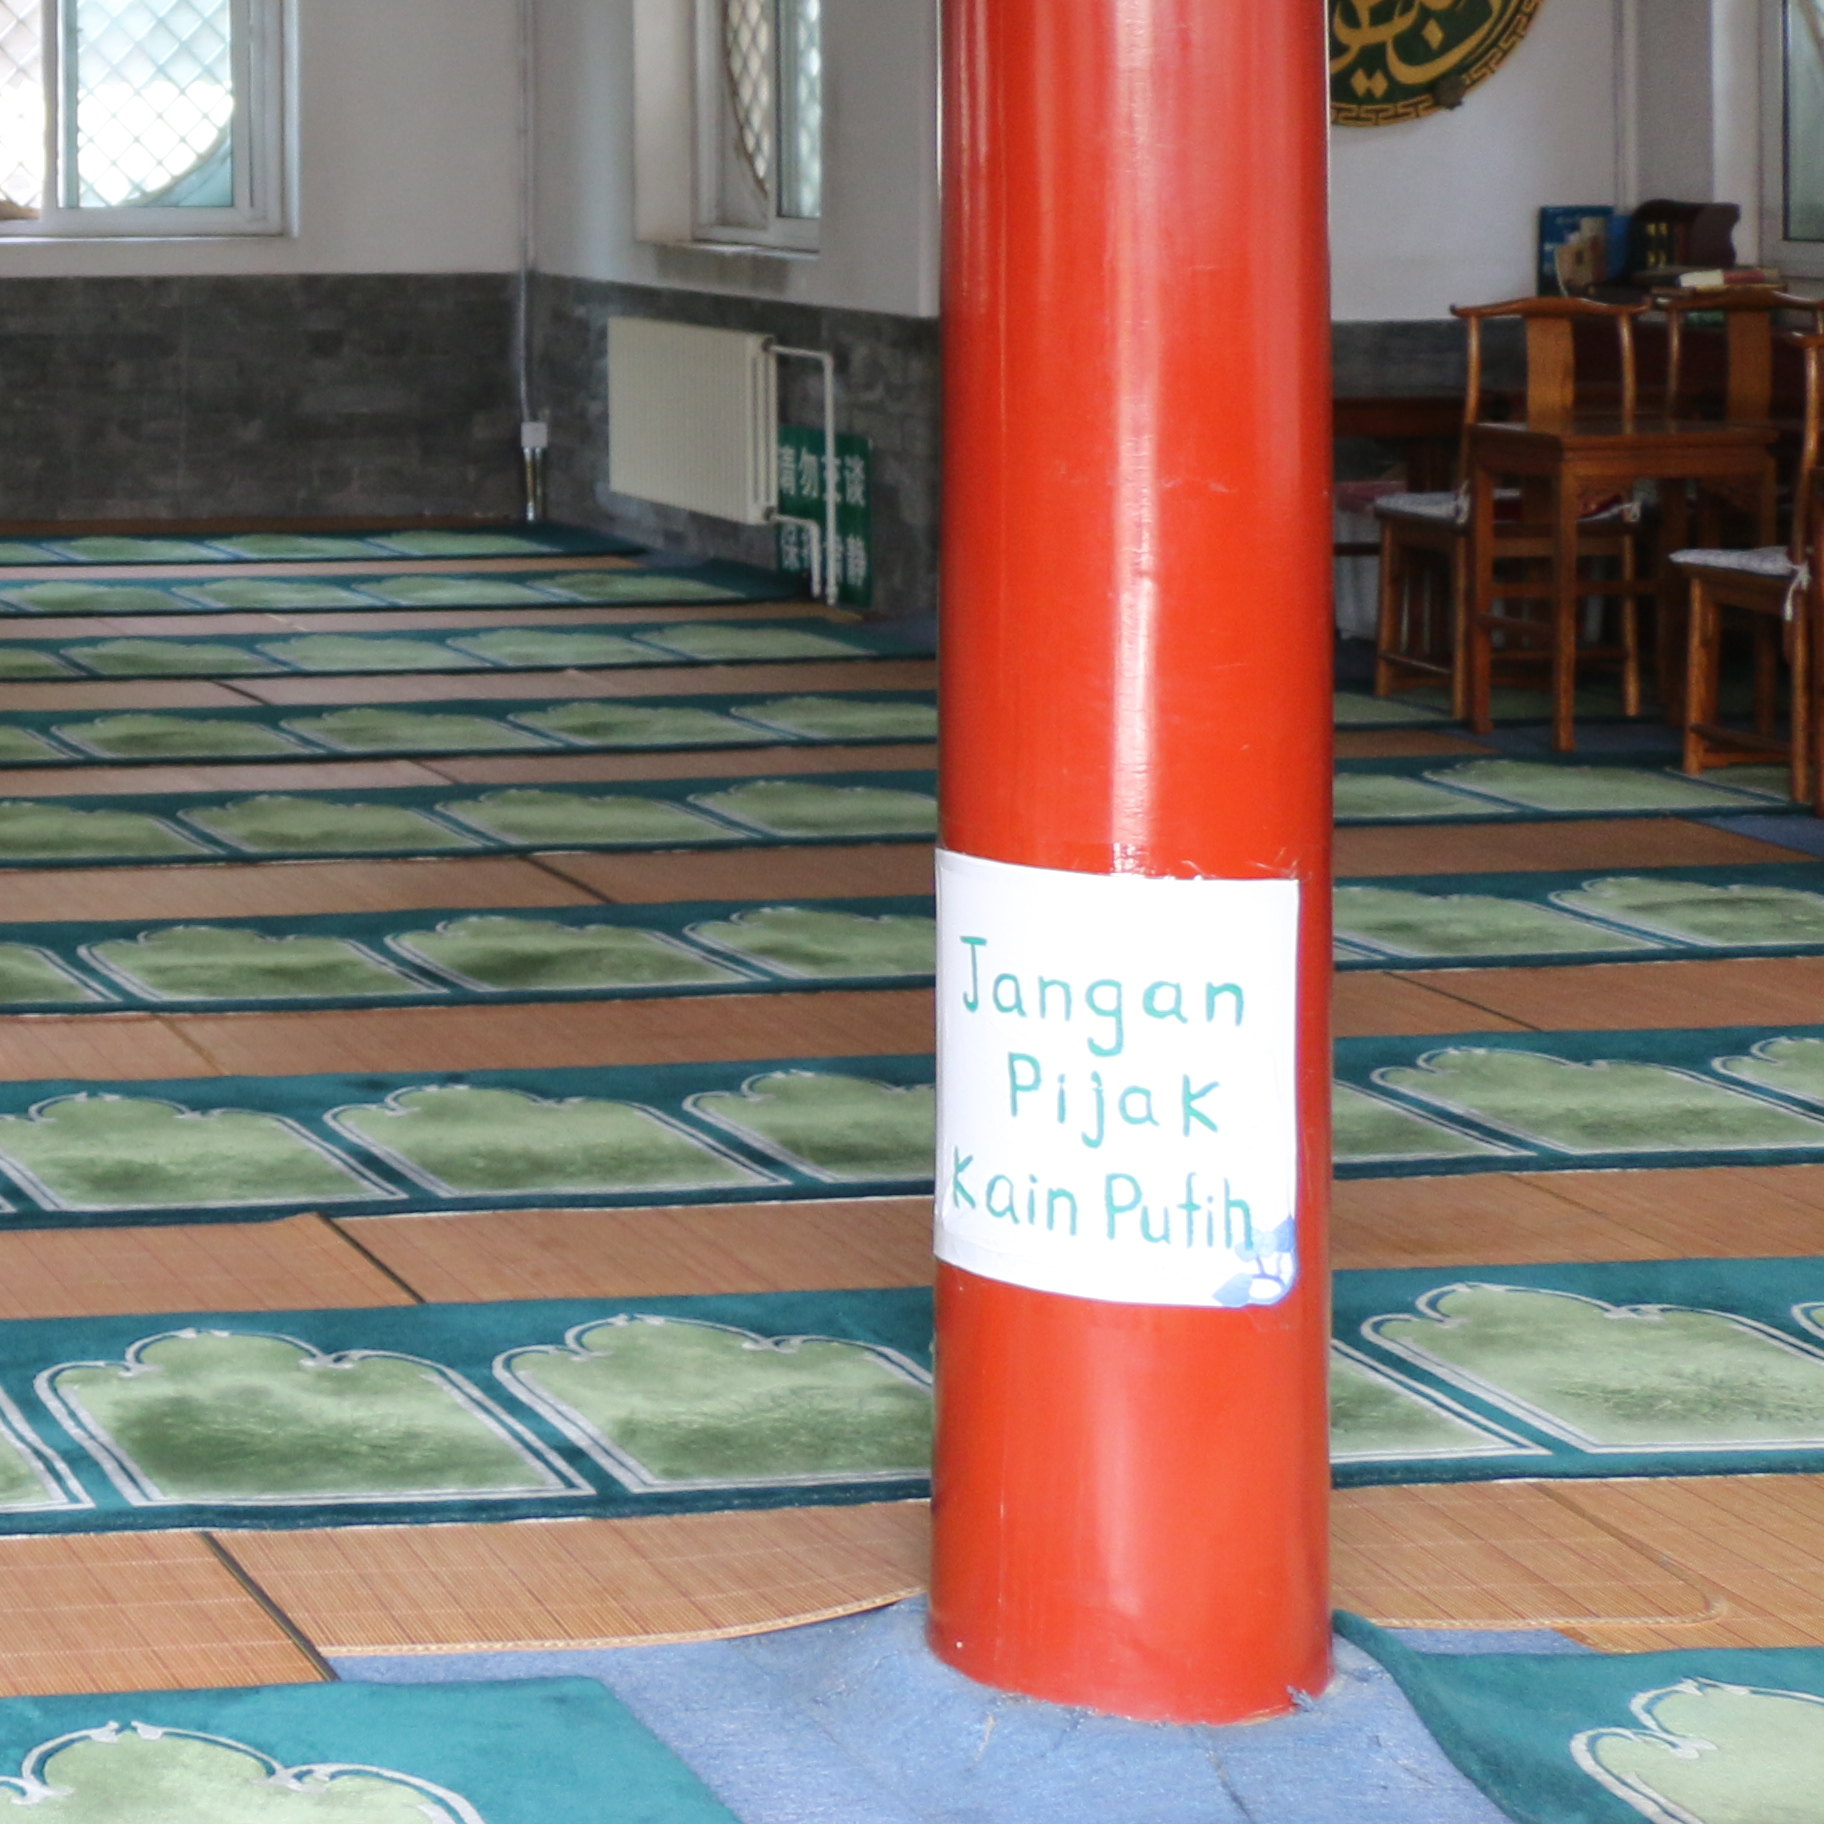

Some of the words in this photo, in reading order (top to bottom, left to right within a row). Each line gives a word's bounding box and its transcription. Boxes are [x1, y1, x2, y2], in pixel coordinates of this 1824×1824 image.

[959, 935, 1245, 1058] Jangan
[1007, 1051, 1220, 1150] Pijak
[952, 1144, 1079, 1236] Kain
[1104, 1171, 1258, 1252] Putih
